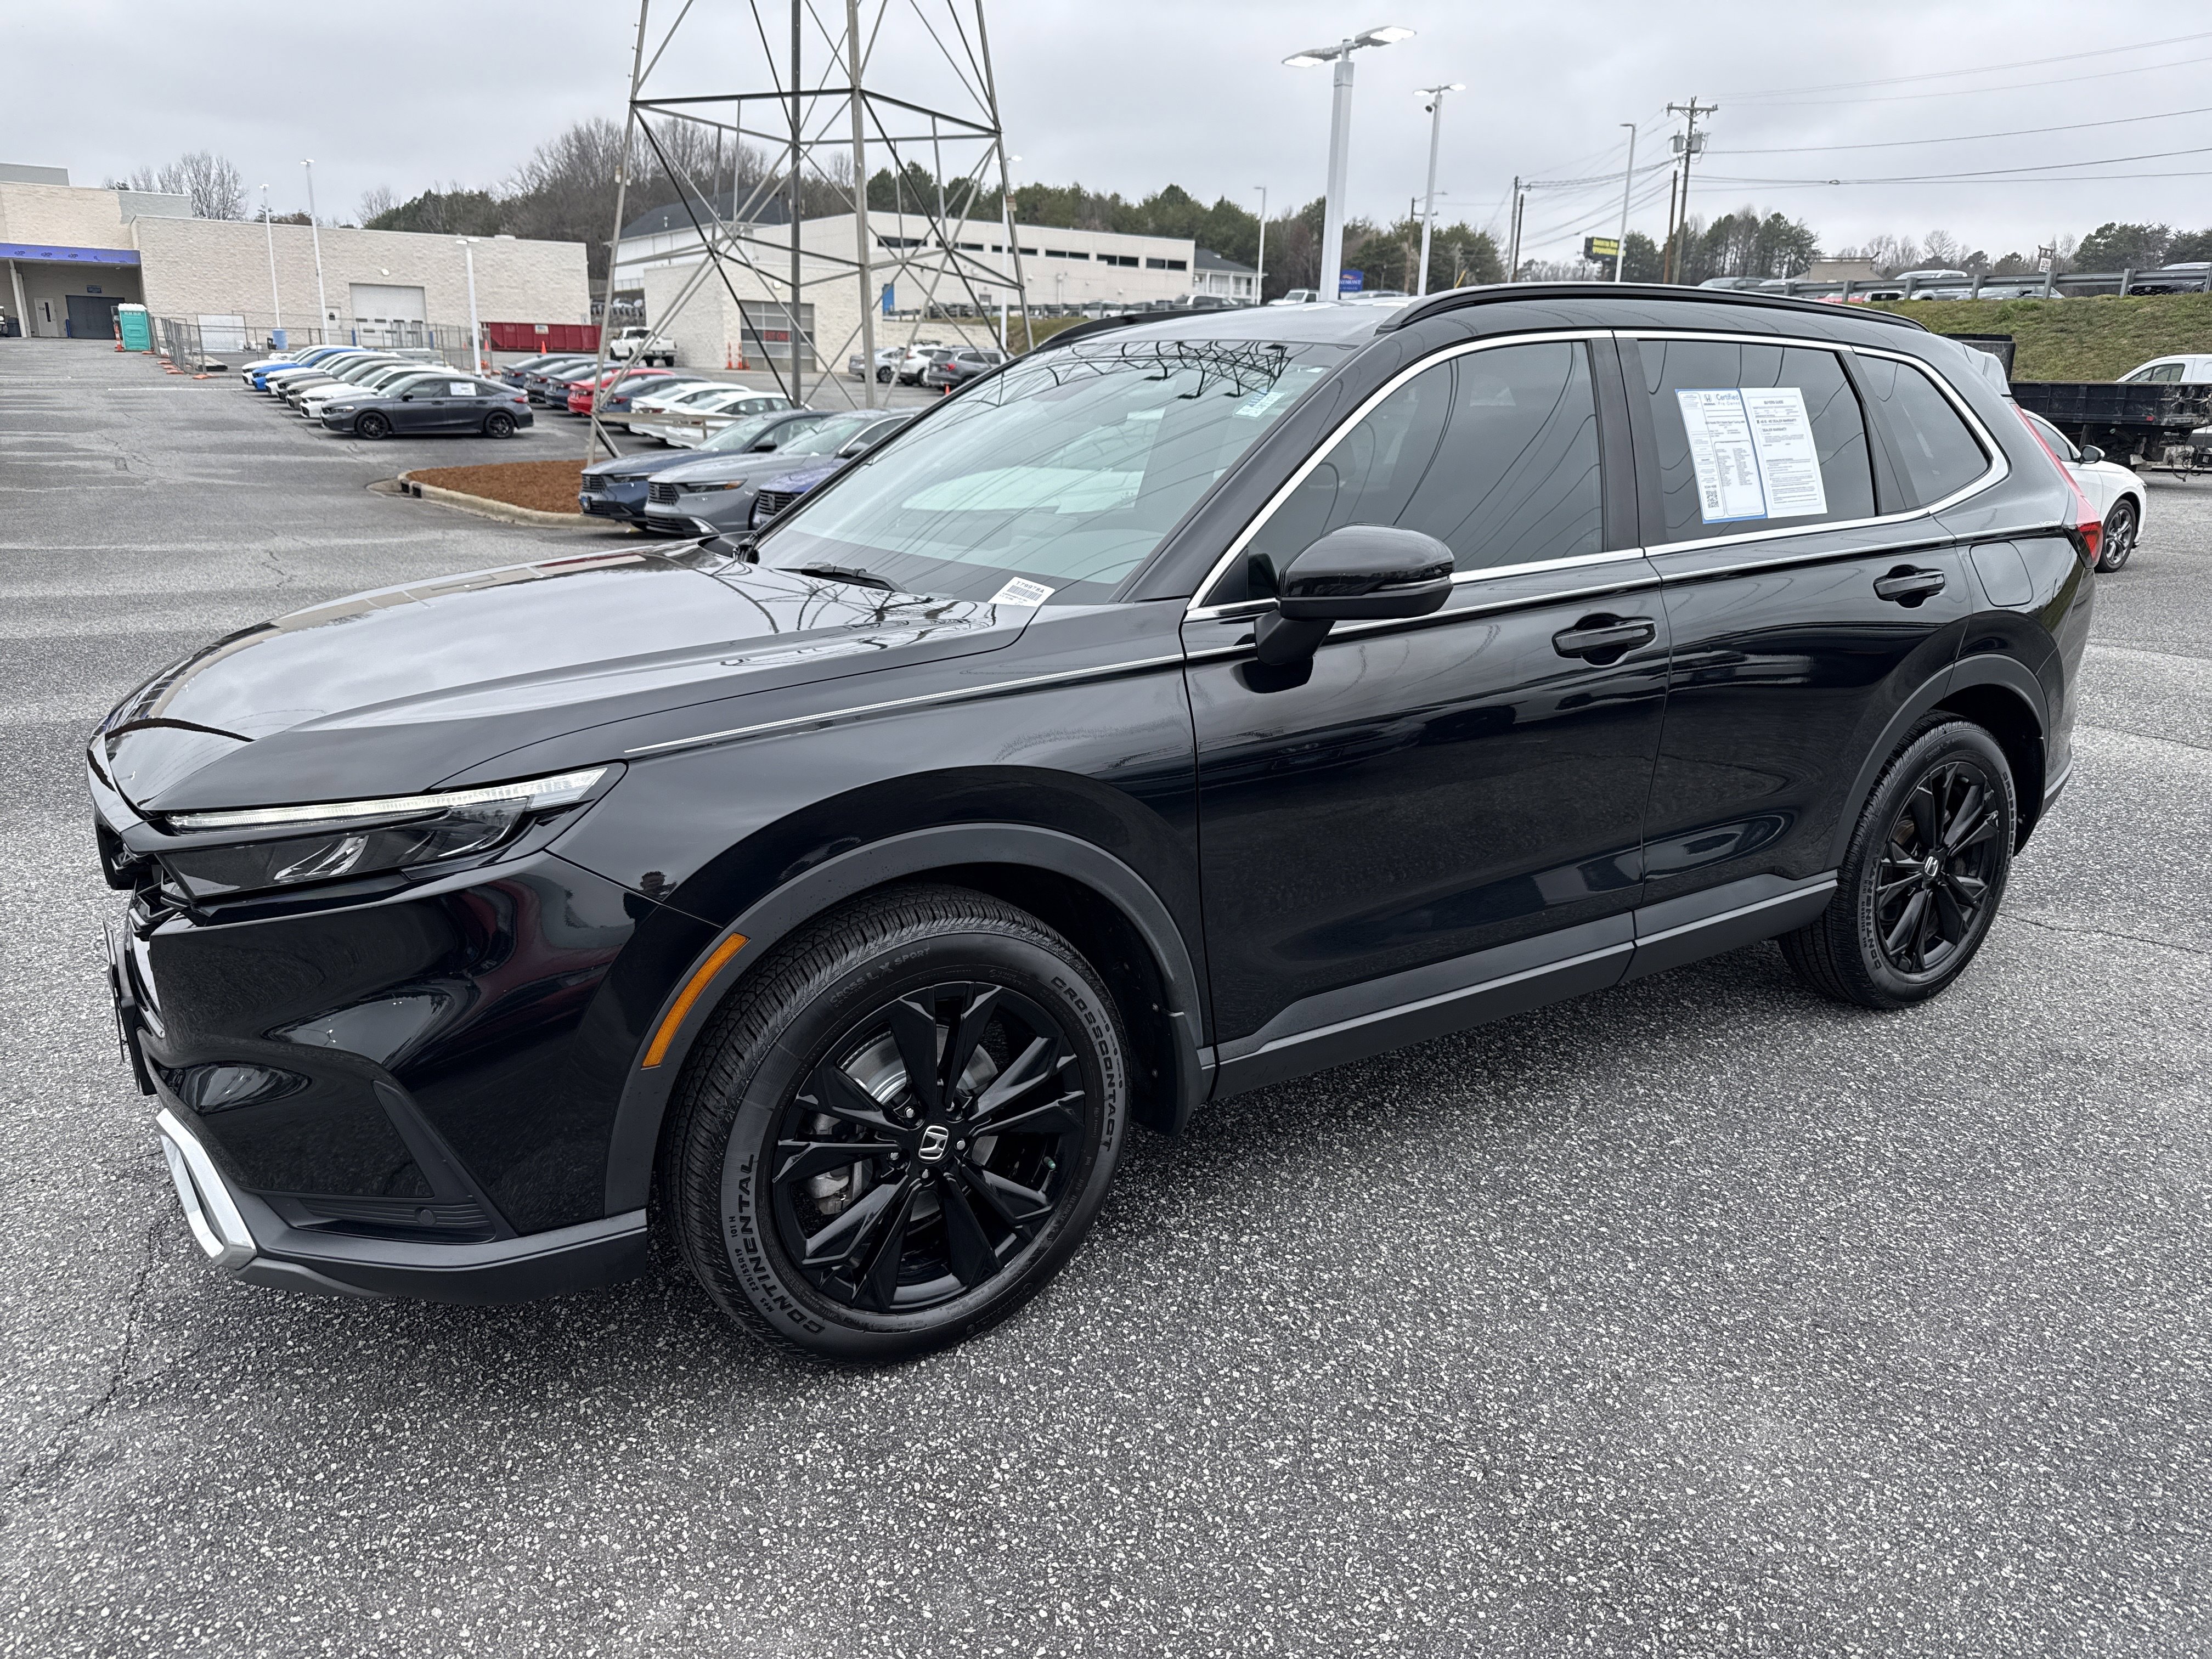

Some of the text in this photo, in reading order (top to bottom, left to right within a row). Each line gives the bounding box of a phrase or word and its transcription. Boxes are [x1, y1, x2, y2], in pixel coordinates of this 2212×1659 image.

[830, 977, 865, 1005] CROSS
[894, 947, 930, 966] SPORT
[1050, 976, 1116, 1152] CROSSCONTACT
[735, 1248, 759, 1293] 235/55R19
[738, 1154, 825, 1335] CONTINENTAL
